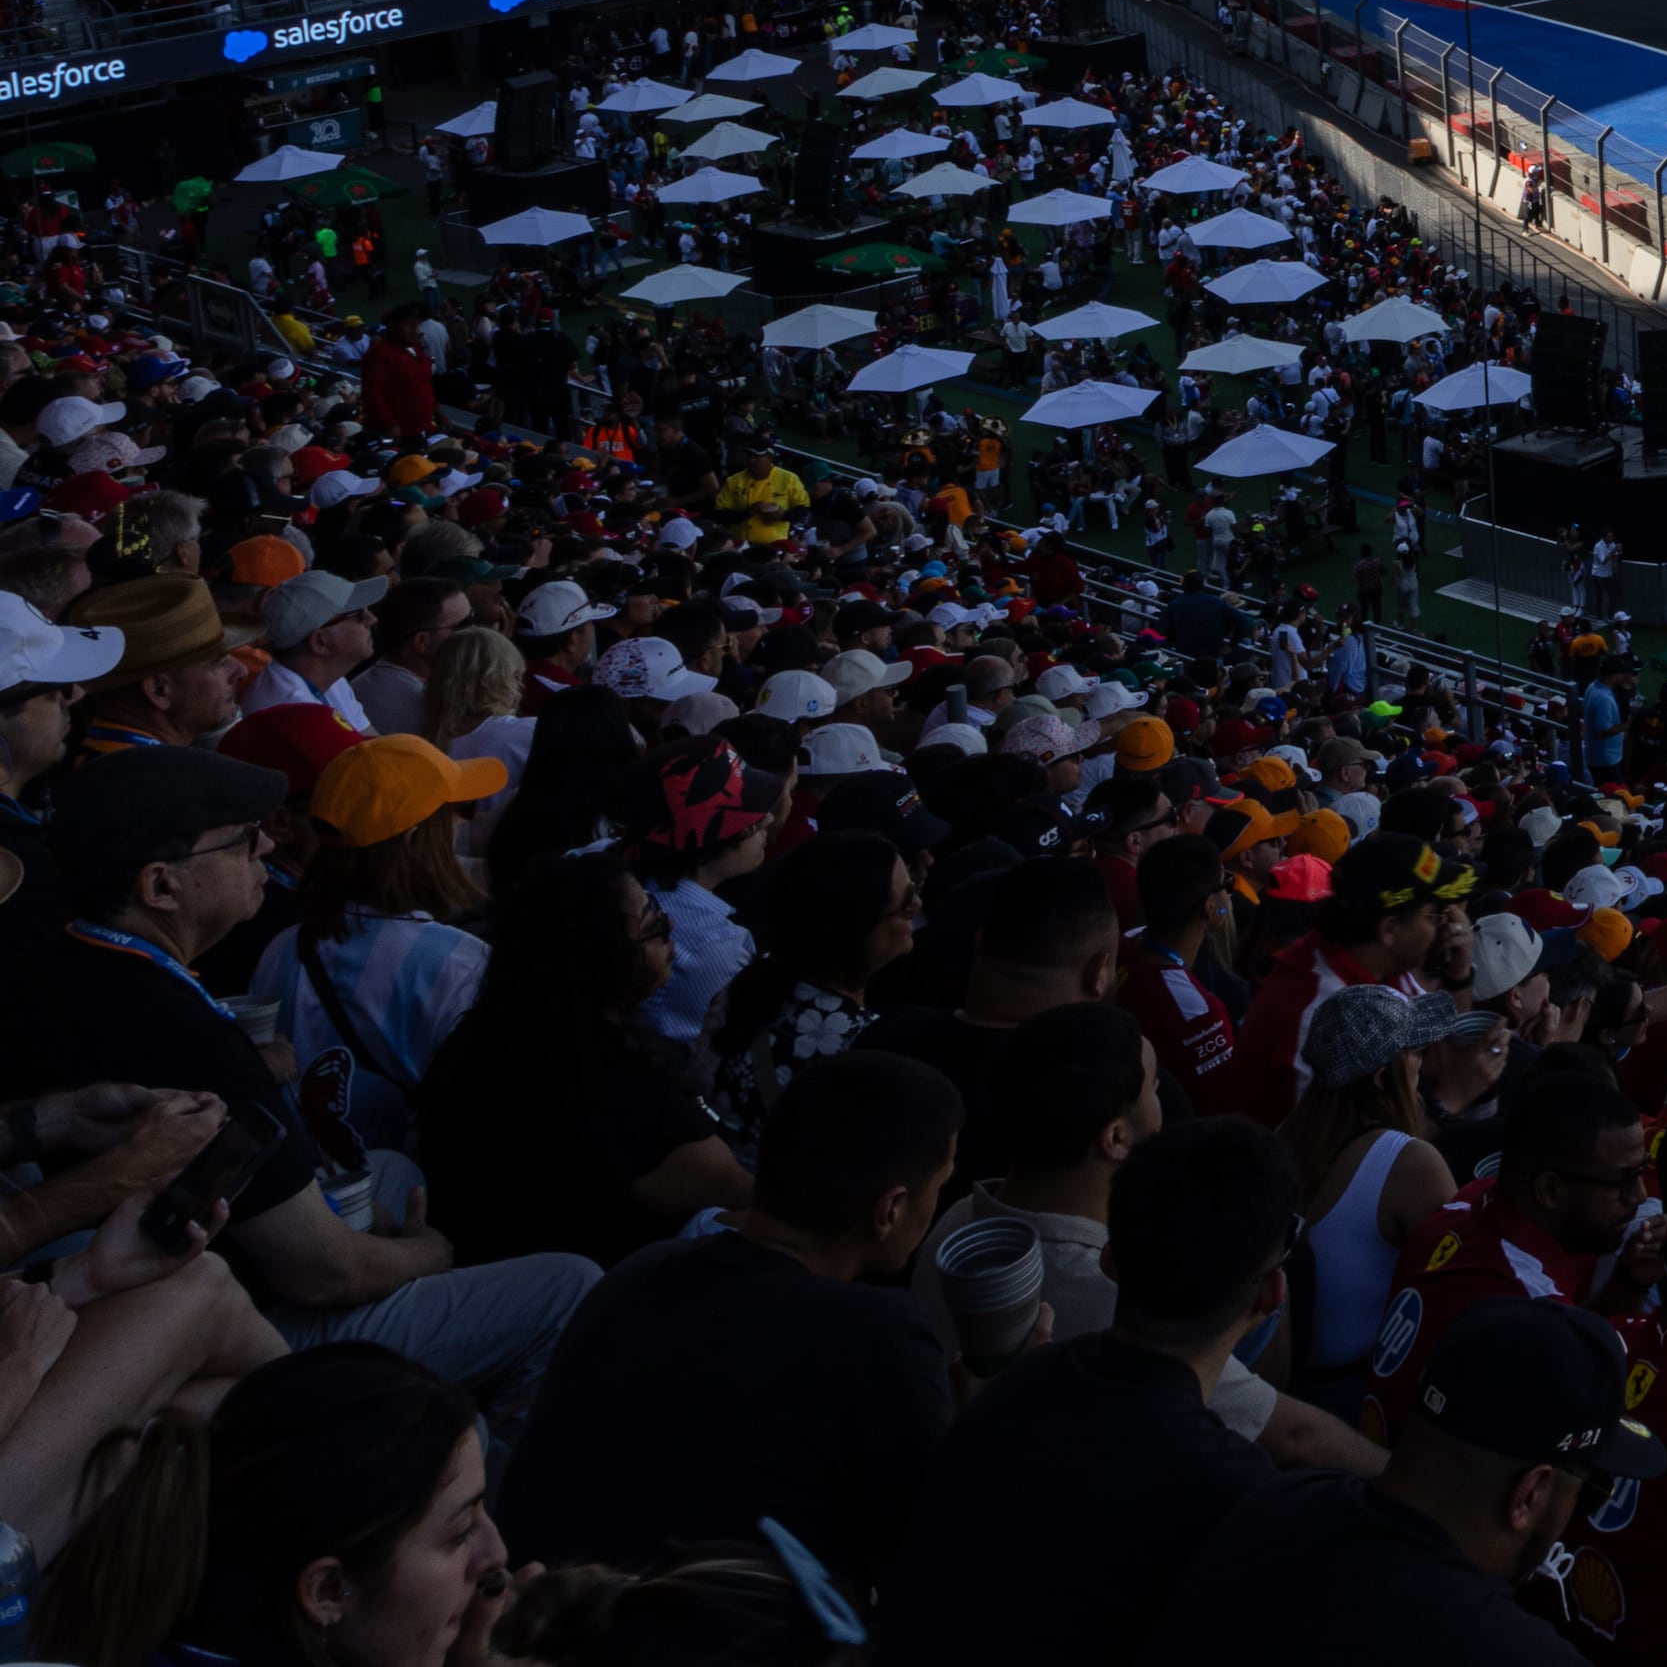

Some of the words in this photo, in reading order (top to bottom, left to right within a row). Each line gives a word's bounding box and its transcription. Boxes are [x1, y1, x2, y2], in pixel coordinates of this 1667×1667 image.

[274, 8, 402, 44] salesforce
[1194, 1035, 1227, 1060] ZCG
[1374, 1295, 1416, 1372] hp
